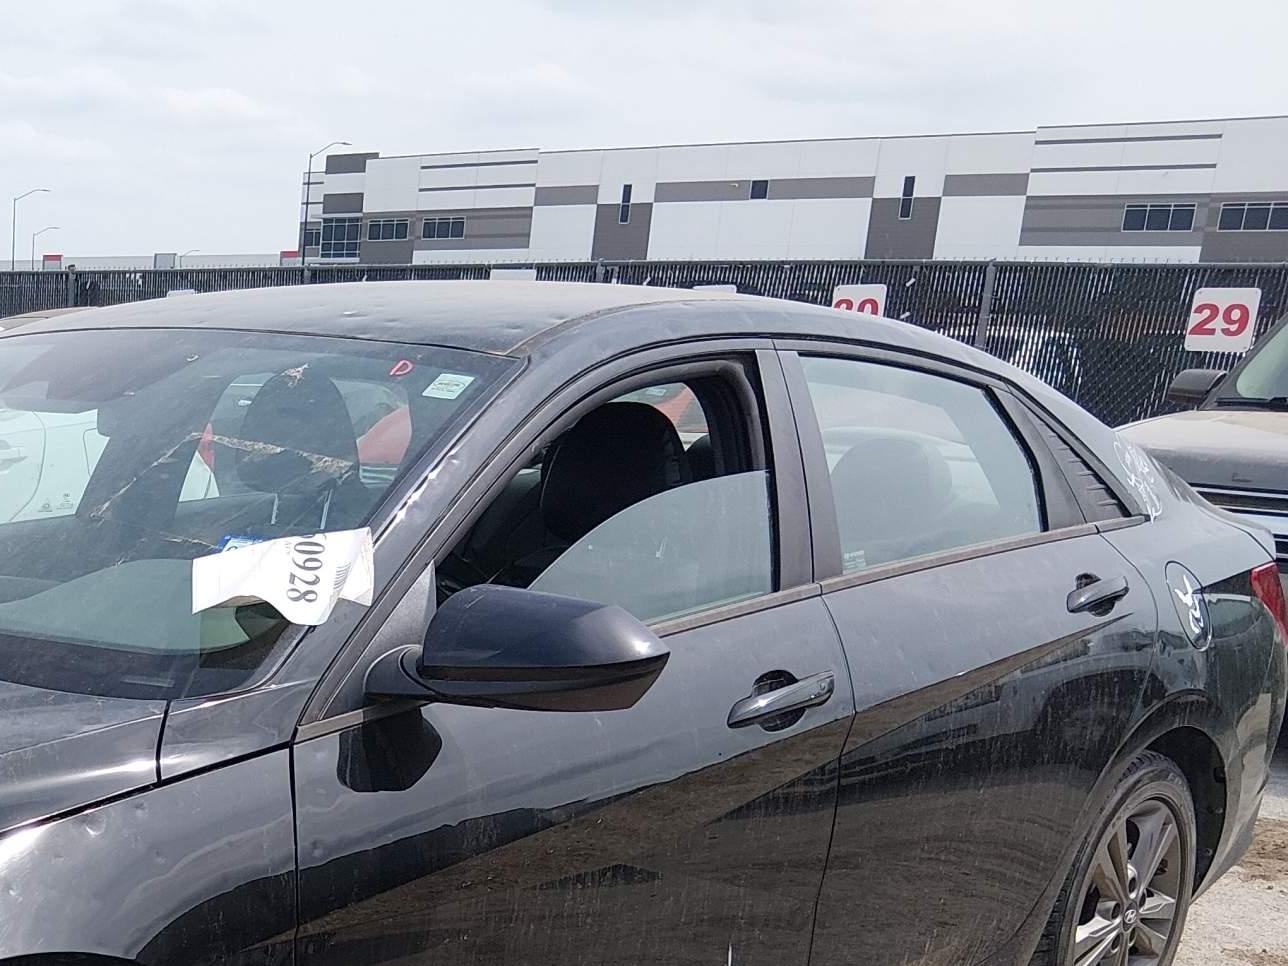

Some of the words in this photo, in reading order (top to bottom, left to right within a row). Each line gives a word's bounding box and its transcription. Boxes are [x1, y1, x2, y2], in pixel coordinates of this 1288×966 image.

[1188, 303, 1250, 337] 29
[389, 359, 413, 376] D
[286, 534, 327, 603] 0928
